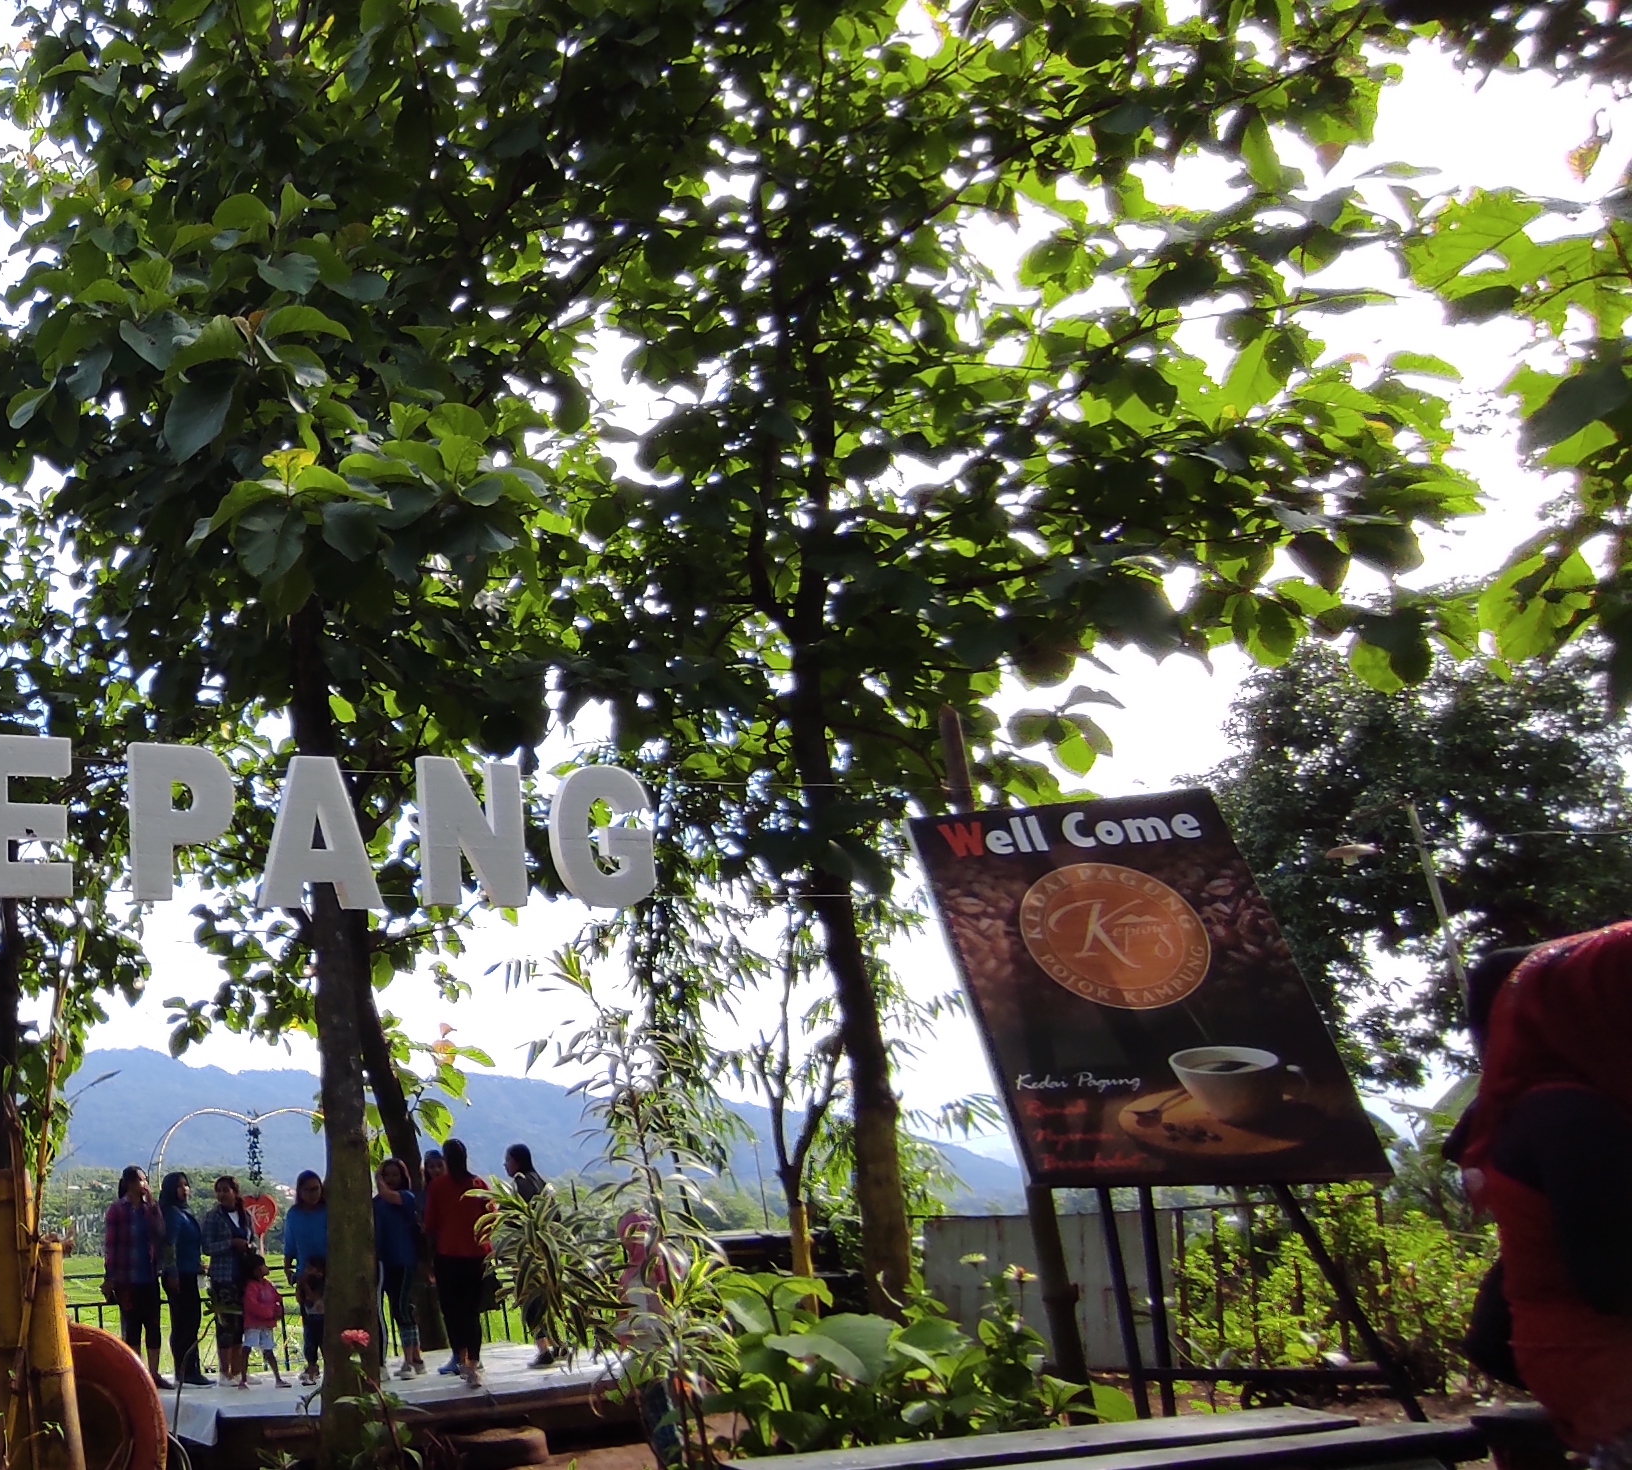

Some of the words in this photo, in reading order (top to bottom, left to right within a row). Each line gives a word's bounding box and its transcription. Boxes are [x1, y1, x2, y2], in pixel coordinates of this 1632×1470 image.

[936, 814, 1051, 858] Well
[1061, 811, 1203, 848] Come
[1025, 873, 1069, 939] KEDAI
[1076, 868, 1198, 929] PAGUNG
[1039, 953, 1111, 999] POJOK
[1123, 945, 1205, 1003] KAMPUNG
[1015, 1073, 1069, 1091] Kedai
[1072, 1071, 1141, 1093] Pagung
